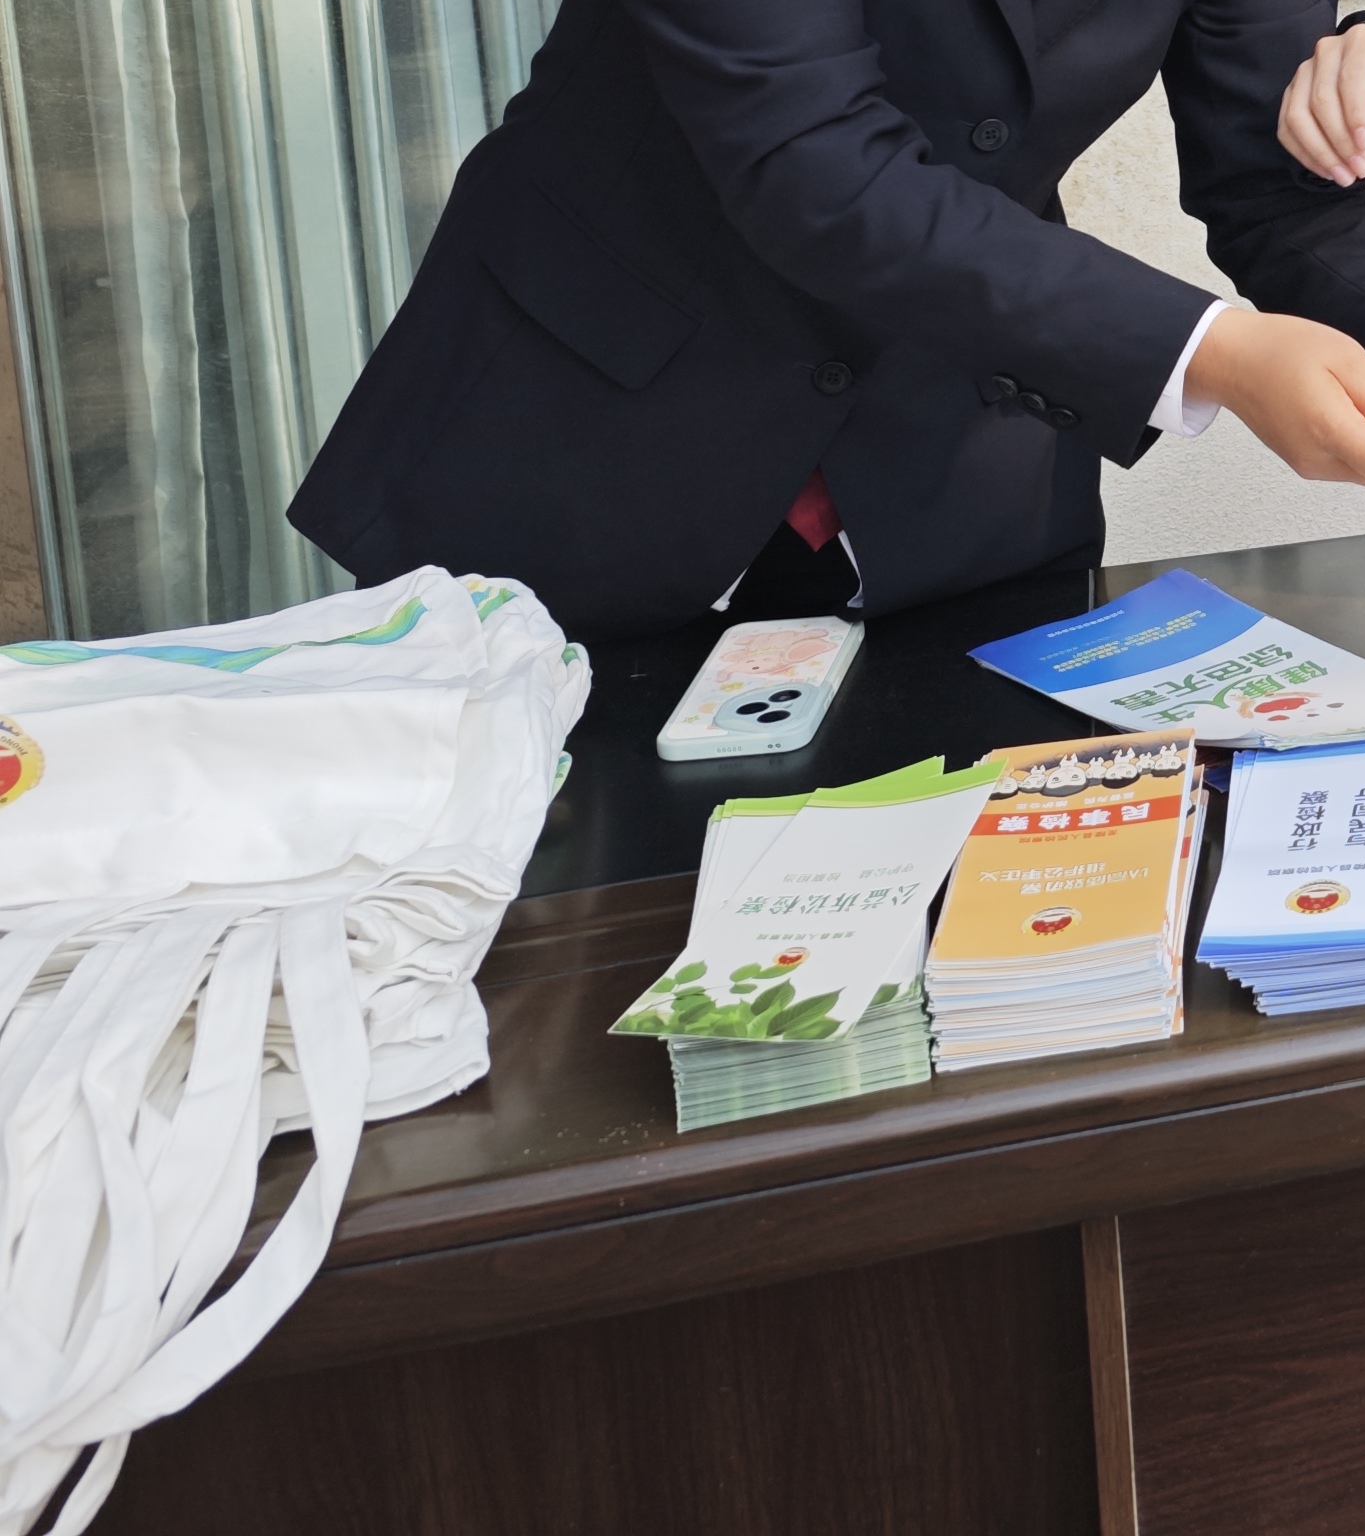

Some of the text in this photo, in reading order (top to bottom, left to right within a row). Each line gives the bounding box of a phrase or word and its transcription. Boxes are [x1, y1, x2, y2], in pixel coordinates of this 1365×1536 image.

[1110, 644, 1293, 711] 绿色无毒
[1141, 660, 1328, 724] 健康人生
[996, 801, 1151, 833] 民事检察
[1287, 790, 1329, 852] 行政检察
[977, 860, 1106, 883] 维护公平正义
[735, 882, 922, 916] 公益诉讼检察
